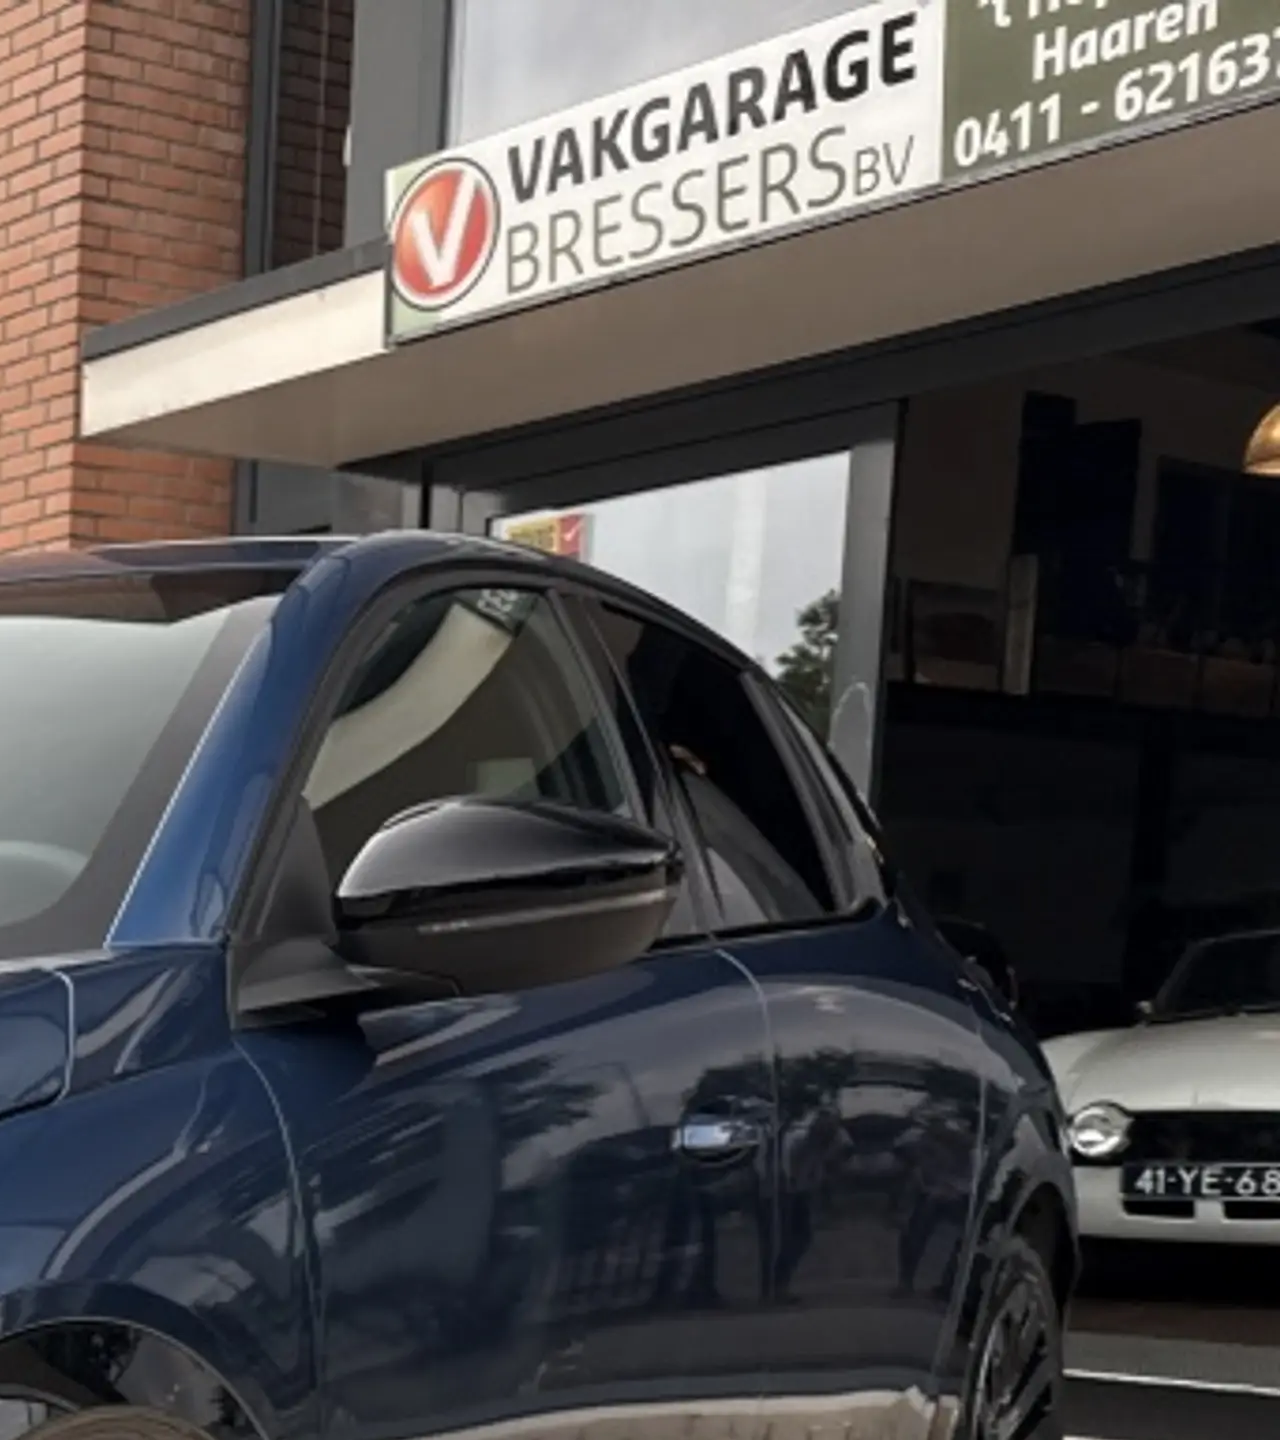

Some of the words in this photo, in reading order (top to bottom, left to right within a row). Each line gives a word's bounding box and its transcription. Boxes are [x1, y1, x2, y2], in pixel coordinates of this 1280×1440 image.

[1032, 0, 1218, 83] Haaren
[507, 11, 919, 202] VAKGARAGE
[954, 93, 1061, 167] 0411
[505, 126, 848, 294] BRESSERS
